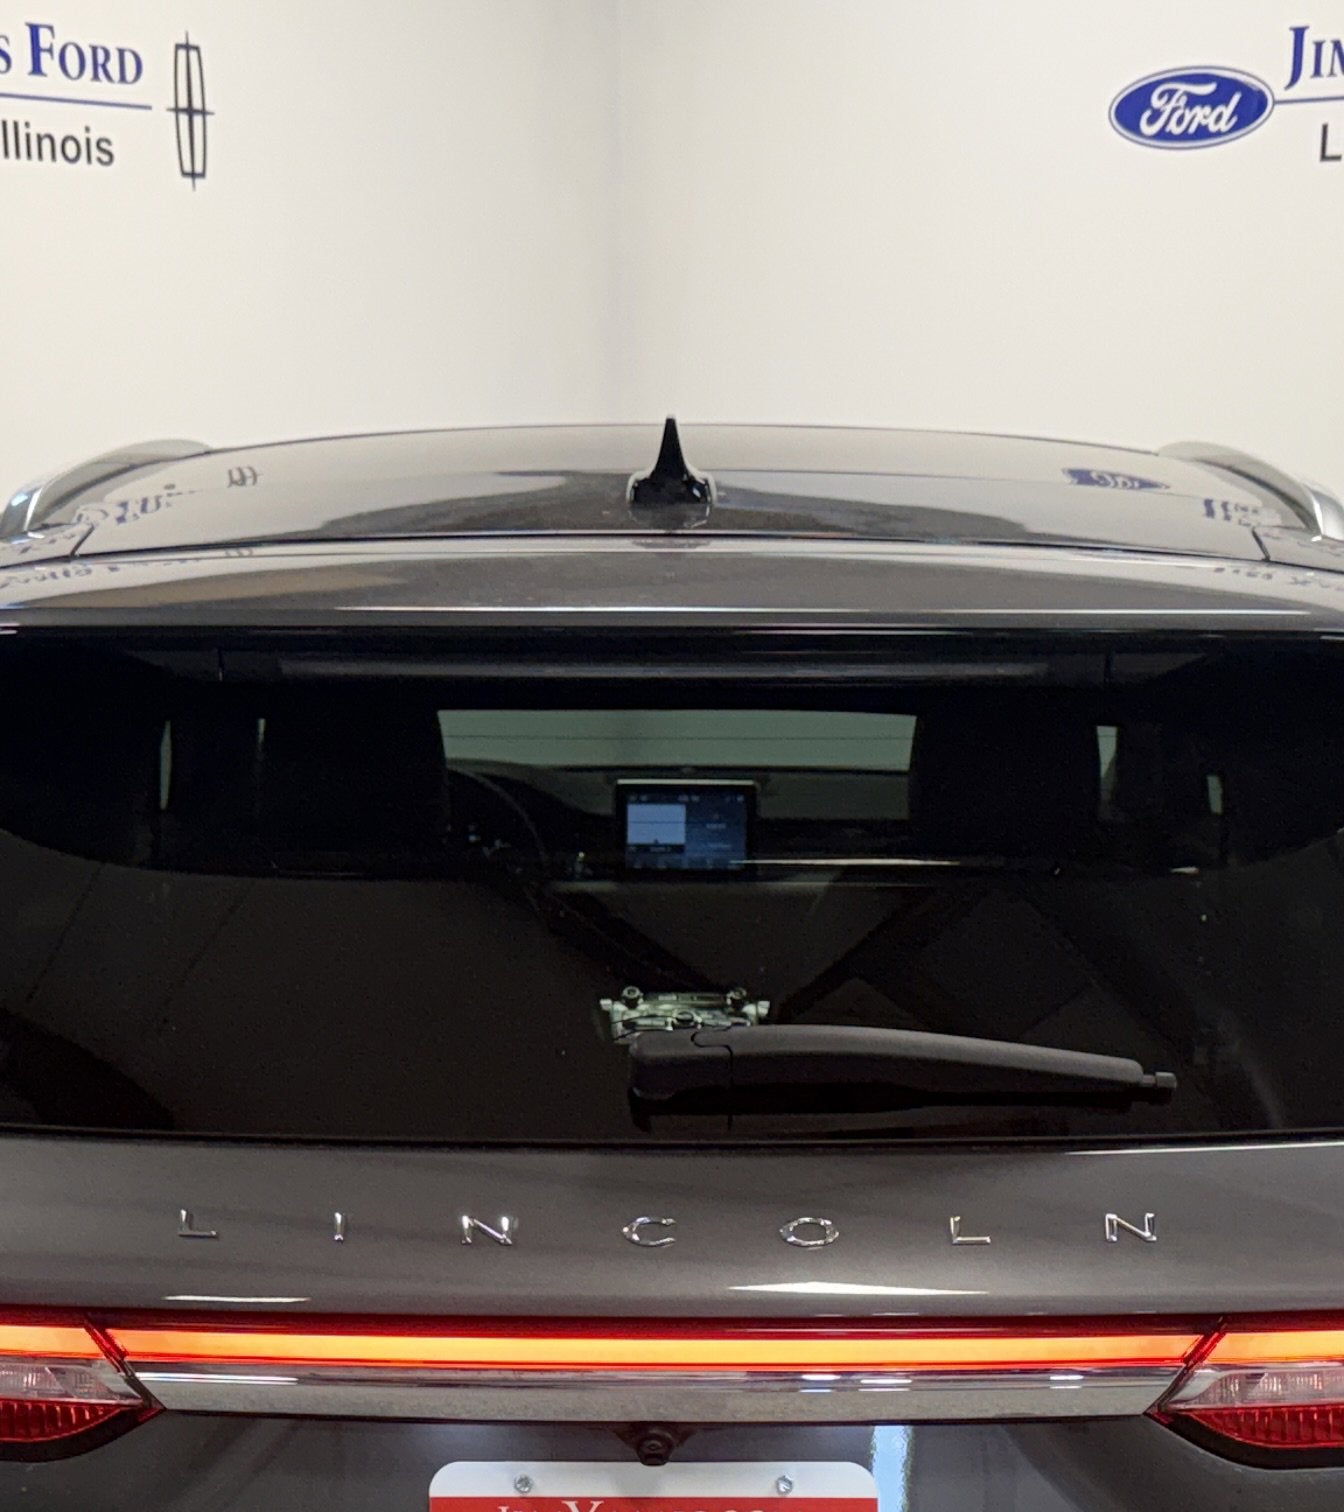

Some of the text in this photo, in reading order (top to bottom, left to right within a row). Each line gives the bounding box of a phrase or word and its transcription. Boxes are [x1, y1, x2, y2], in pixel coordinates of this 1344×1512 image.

[26, 23, 142, 84] FORD
[1139, 81, 1238, 138] Ford
[177, 1208, 1158, 1249] LINCOLN
